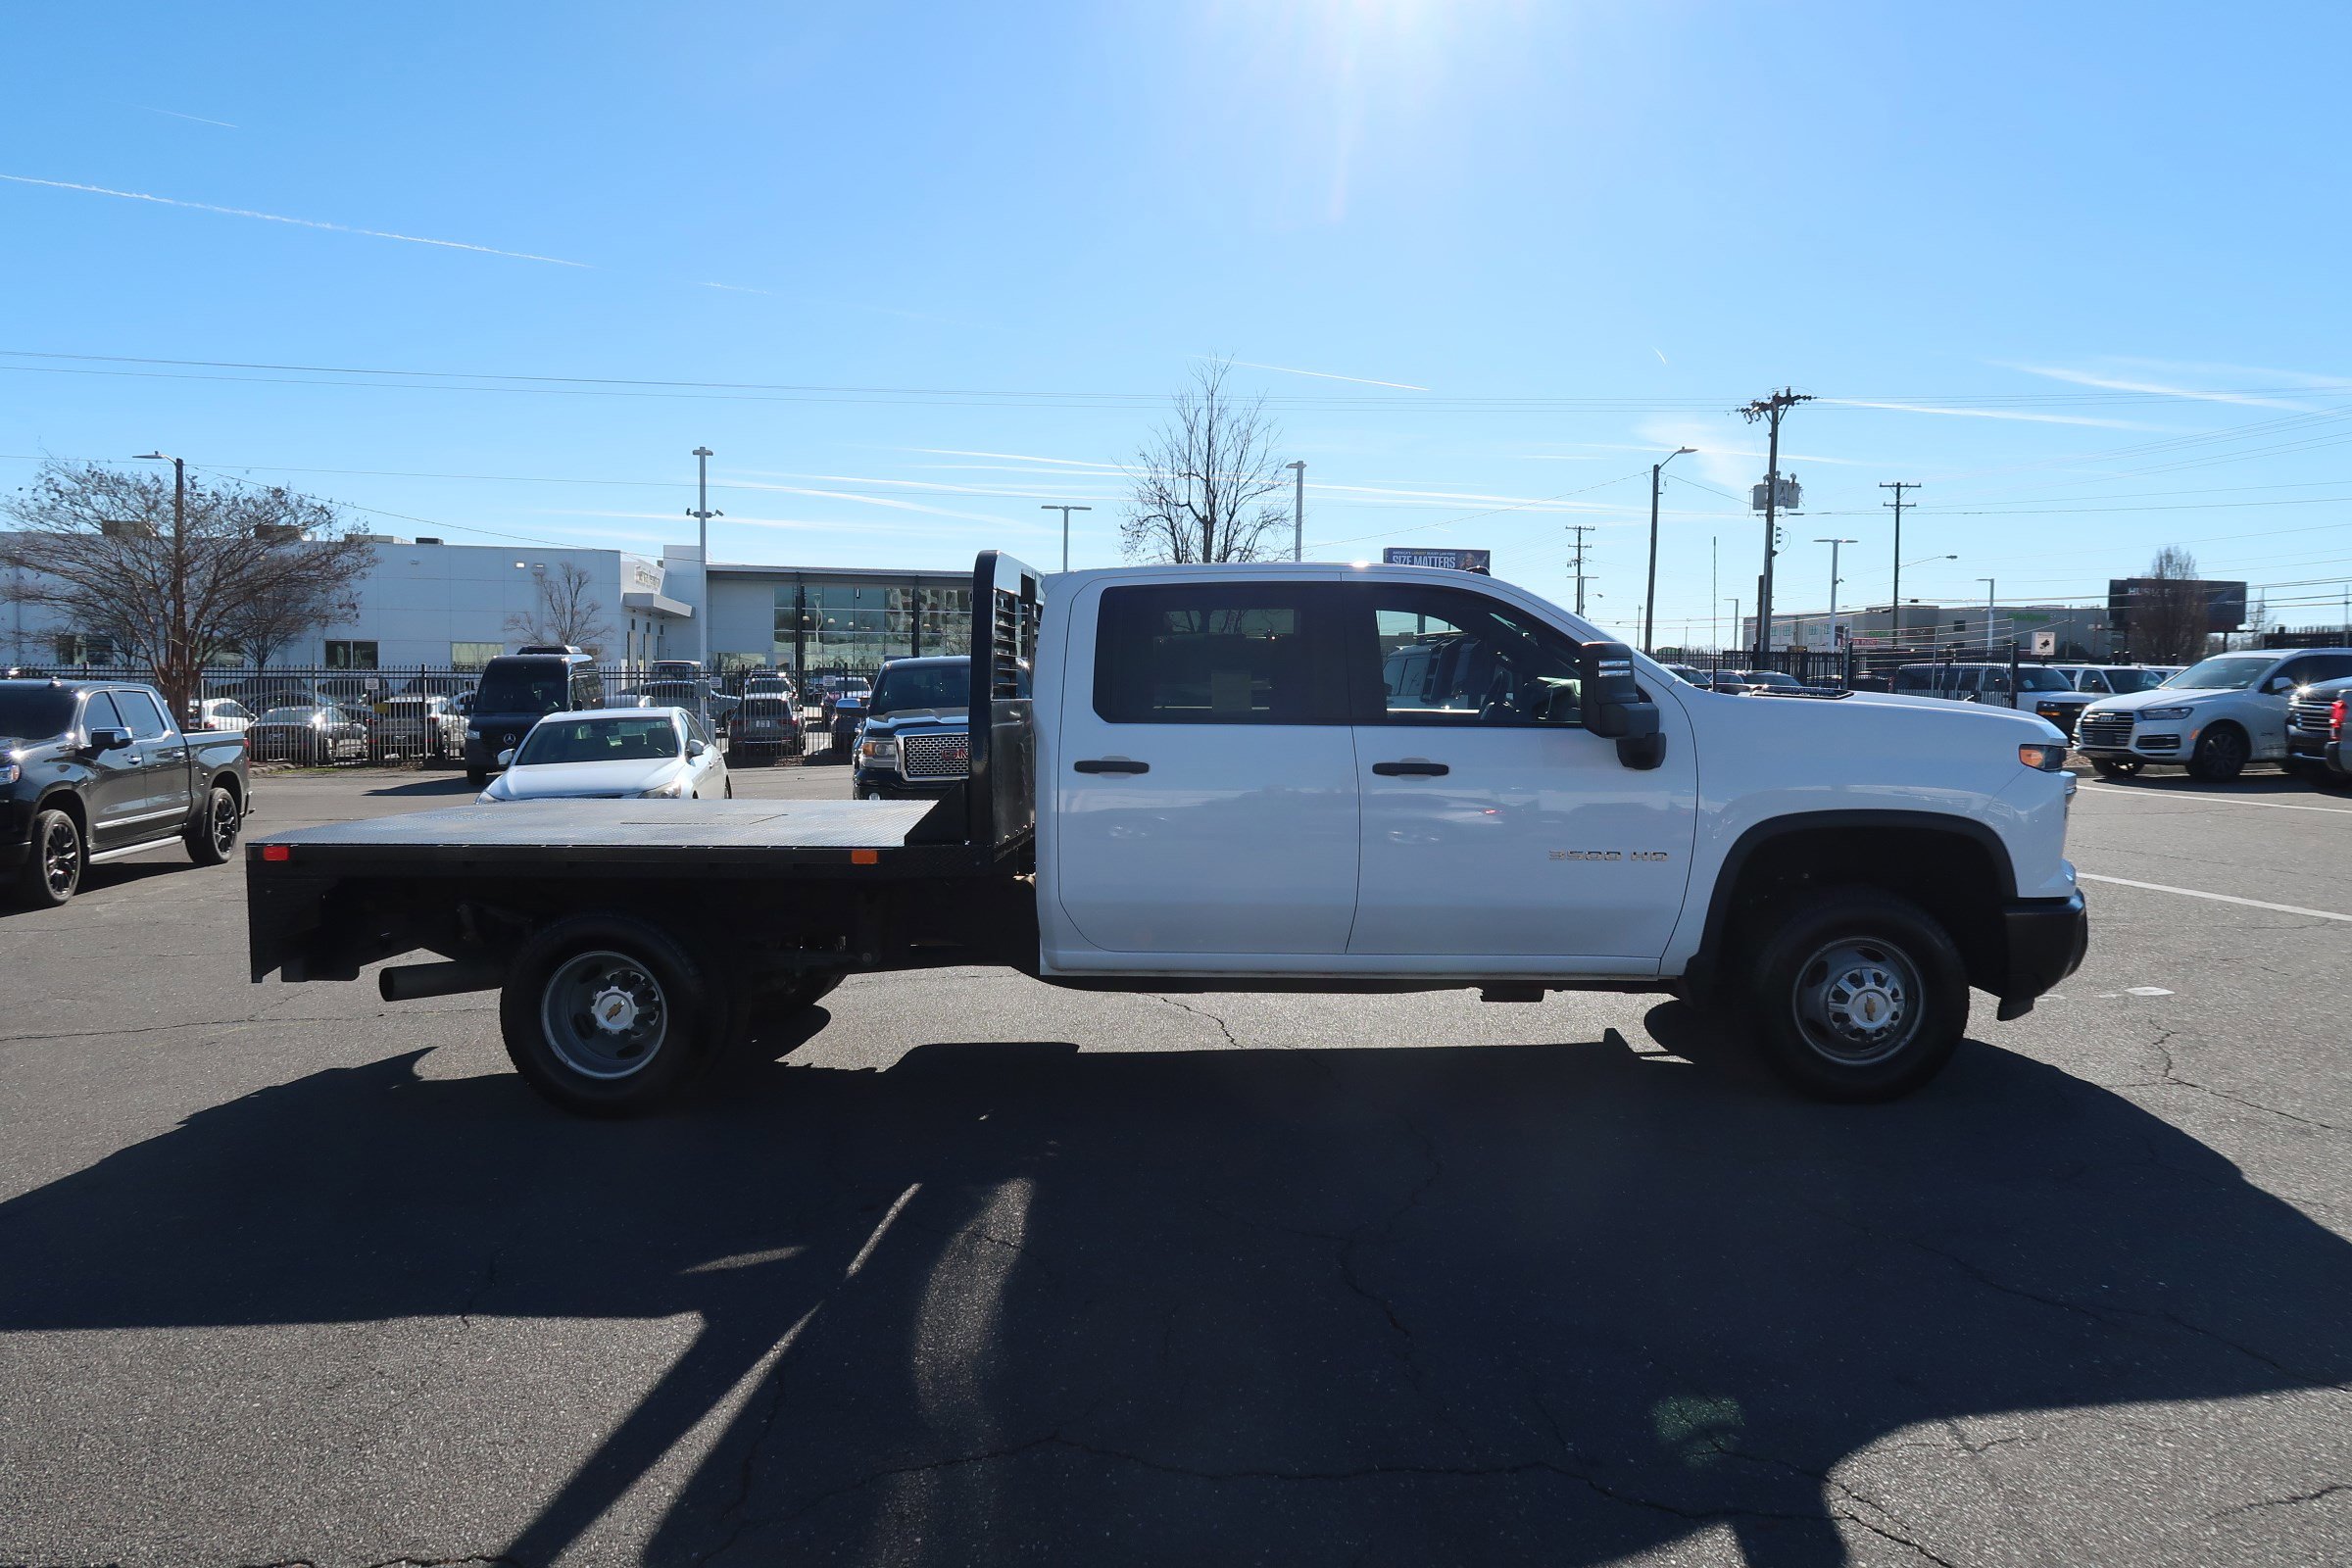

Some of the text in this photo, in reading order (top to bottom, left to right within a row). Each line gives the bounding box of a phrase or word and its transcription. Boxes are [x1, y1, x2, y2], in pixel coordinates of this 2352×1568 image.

[1393, 555, 1456, 568] SIZE MATTERS
[1548, 851, 1670, 861] 3500 HD
